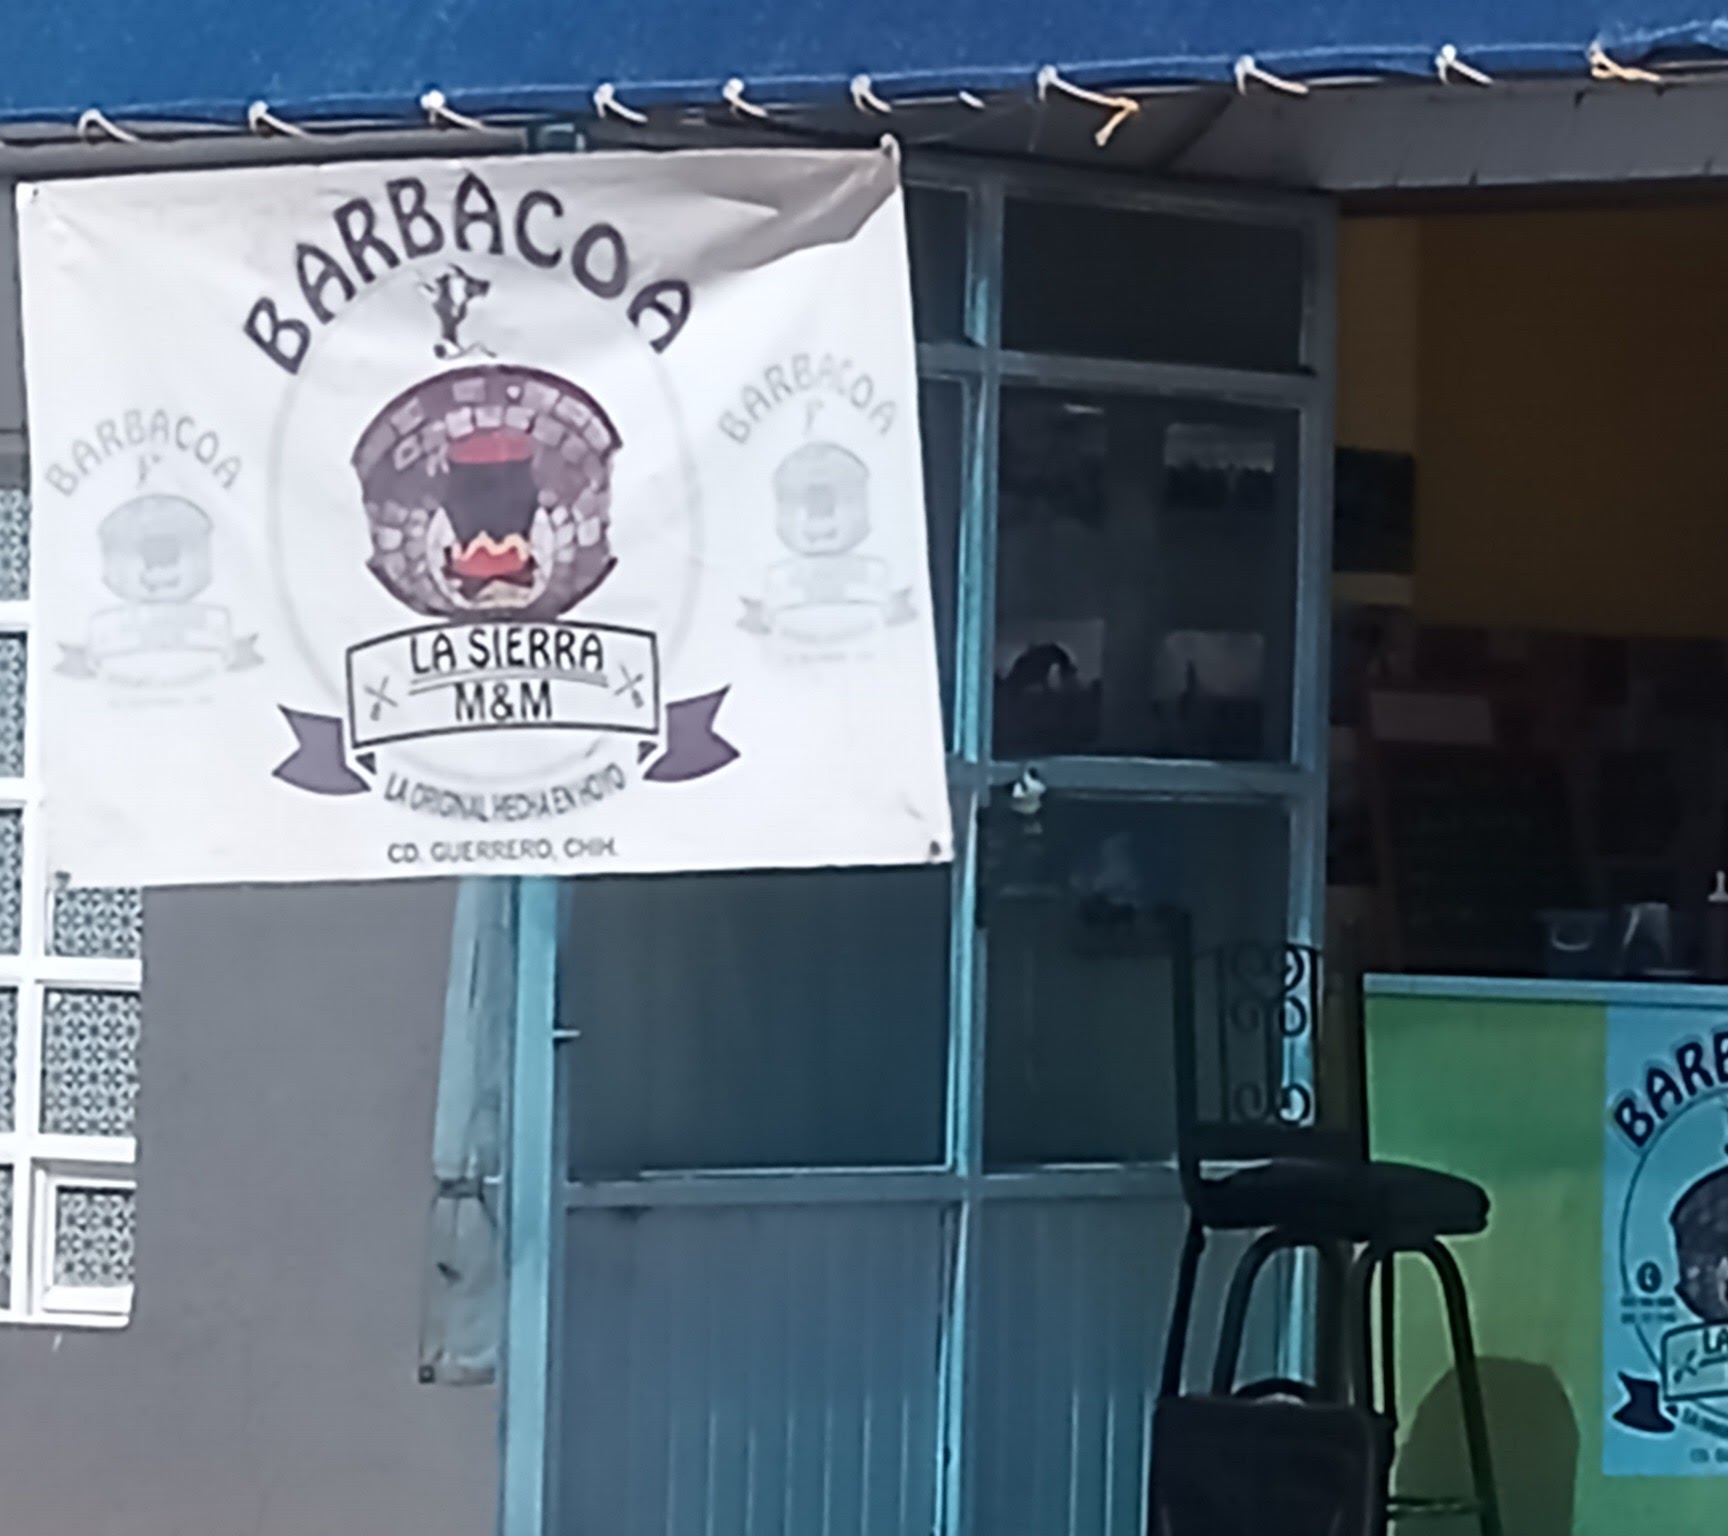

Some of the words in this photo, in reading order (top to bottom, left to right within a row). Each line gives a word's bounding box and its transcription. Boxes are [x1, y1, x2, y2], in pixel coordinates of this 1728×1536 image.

[244, 172, 696, 374] BARBACOA
[717, 352, 898, 445] BARBACOA
[45, 408, 243, 497] BARBACOA
[410, 632, 456, 674] LA
[467, 626, 604, 672] SIERRA
[454, 678, 552, 722] M&M
